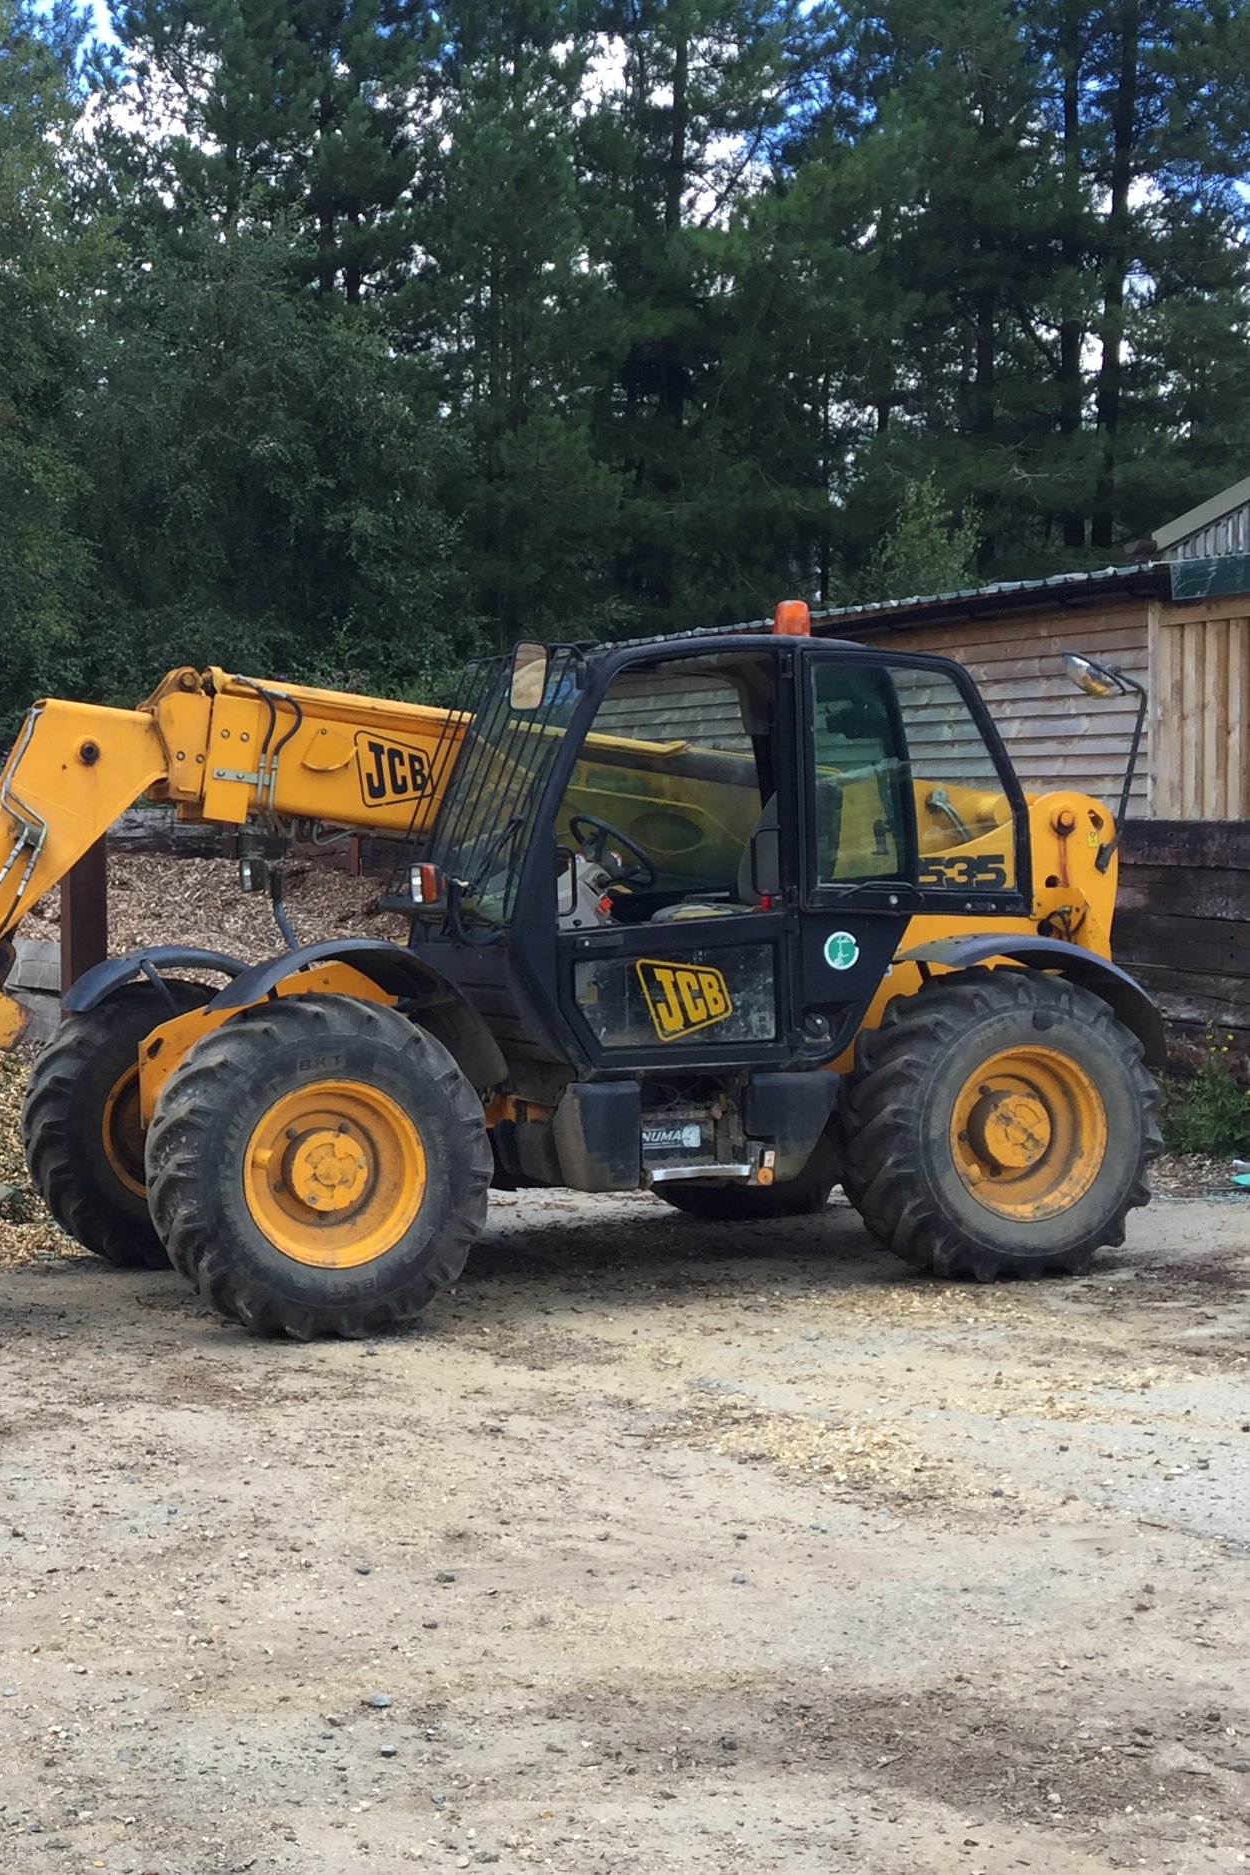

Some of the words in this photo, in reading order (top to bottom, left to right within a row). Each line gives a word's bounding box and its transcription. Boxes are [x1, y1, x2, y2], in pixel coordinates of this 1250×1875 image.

[365, 740, 428, 799] JCB
[917, 854, 1007, 889] 535
[653, 967, 726, 1032] JCB
[299, 1054, 343, 1071] BKT
